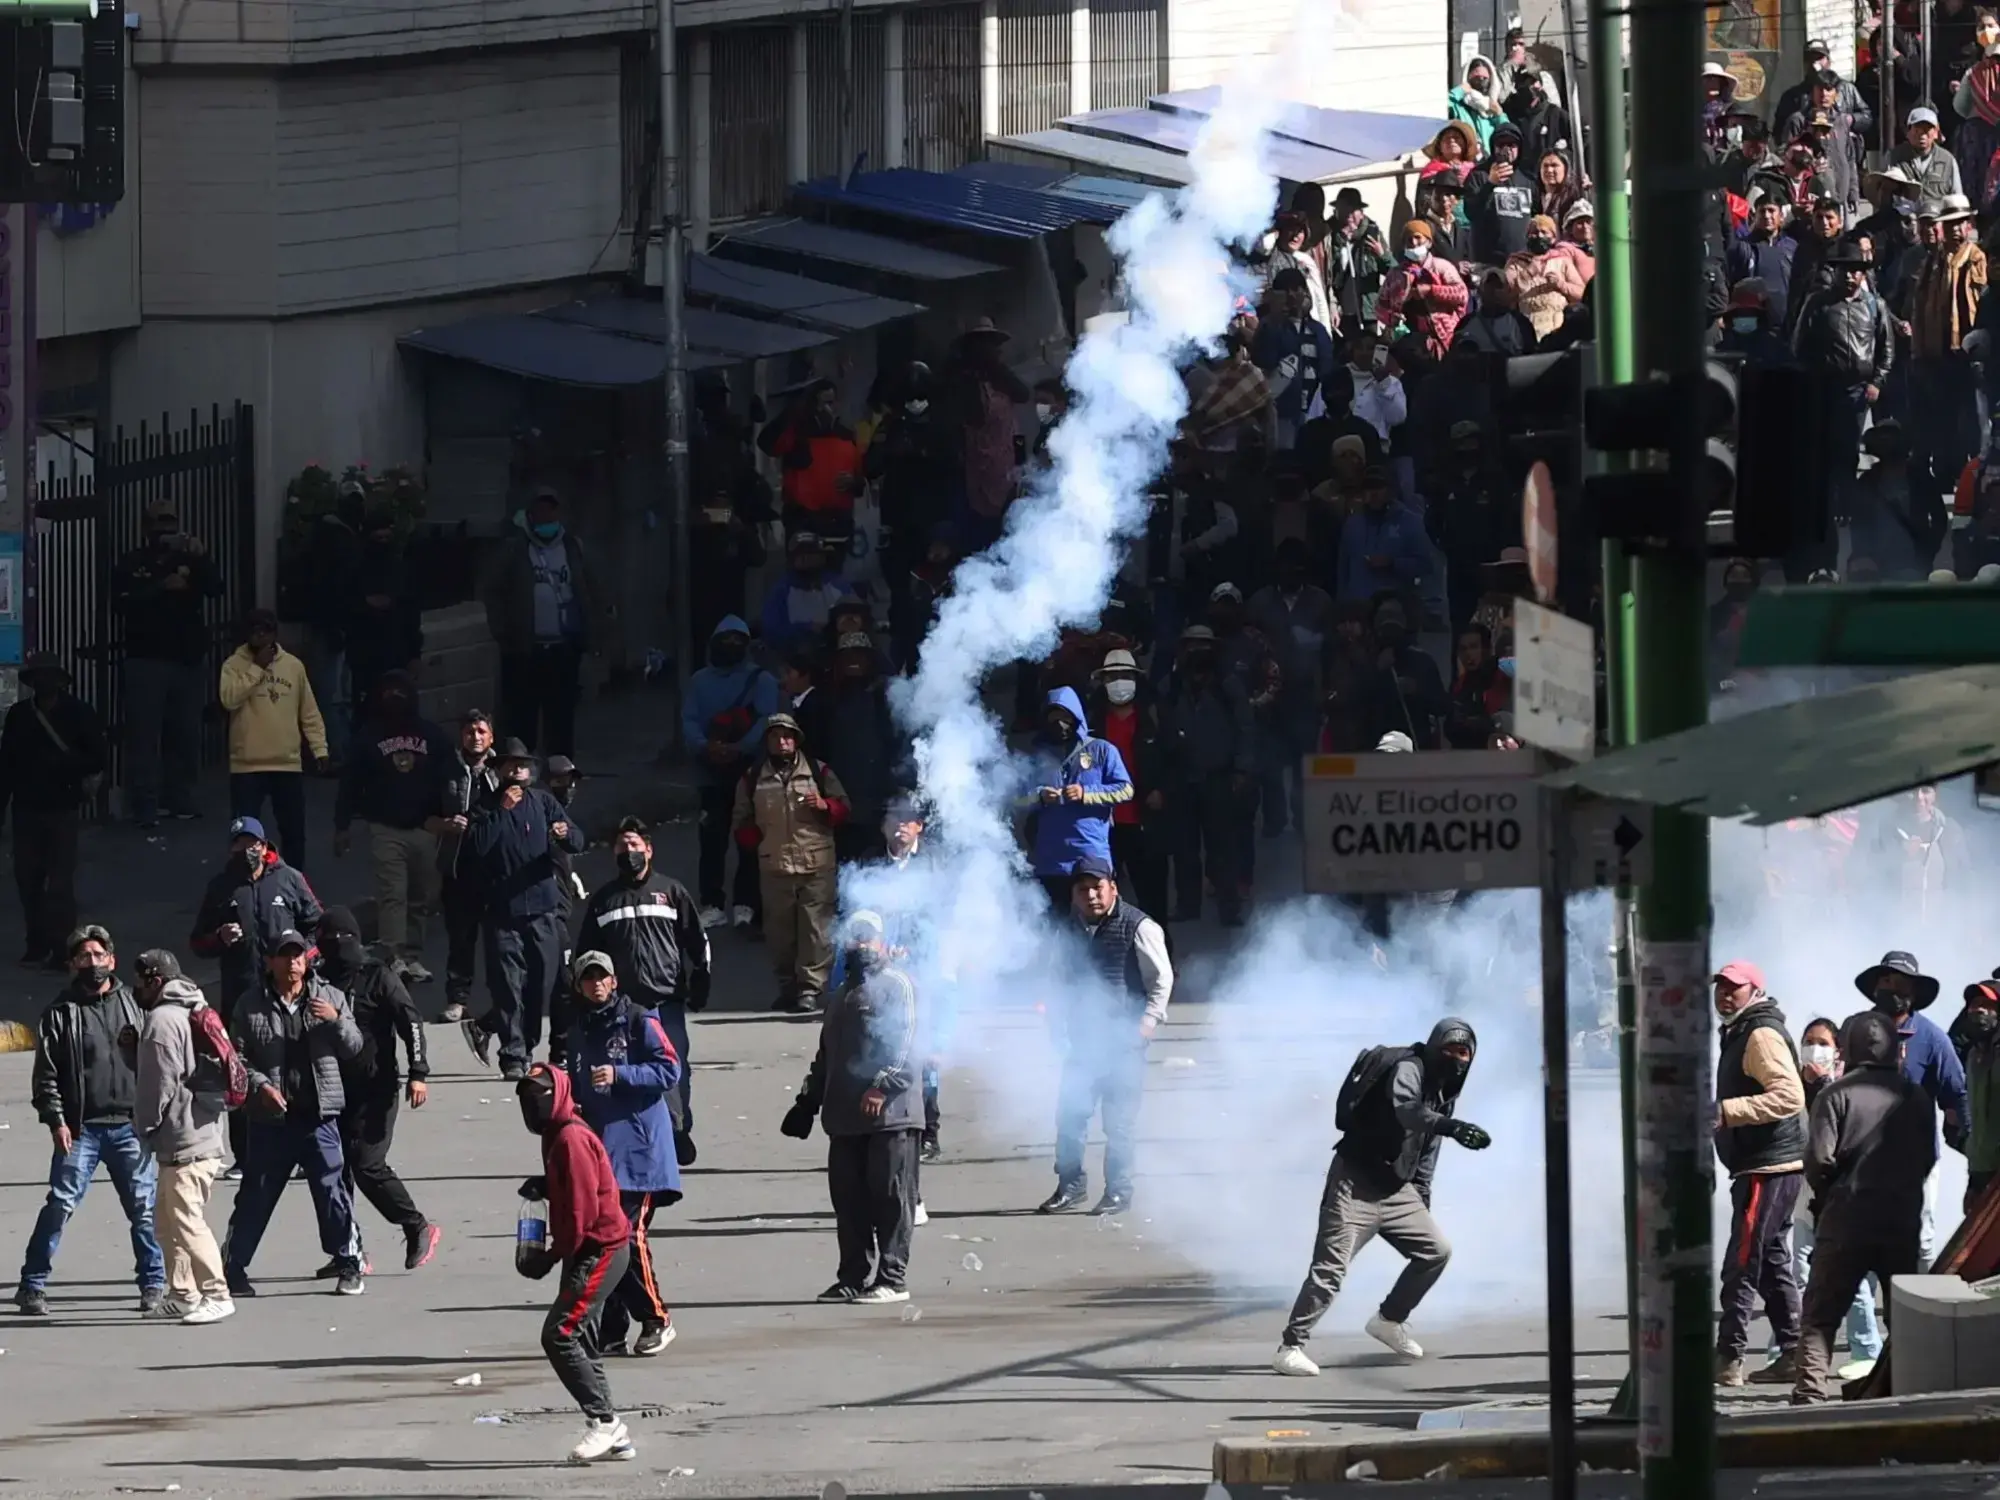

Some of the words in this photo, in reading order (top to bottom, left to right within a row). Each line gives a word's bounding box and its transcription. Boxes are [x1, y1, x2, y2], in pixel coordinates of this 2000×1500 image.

[1329, 791, 1368, 816] AV.
[1377, 789, 1518, 815] Eliodoro
[1331, 818, 1522, 857] CAMACHO
